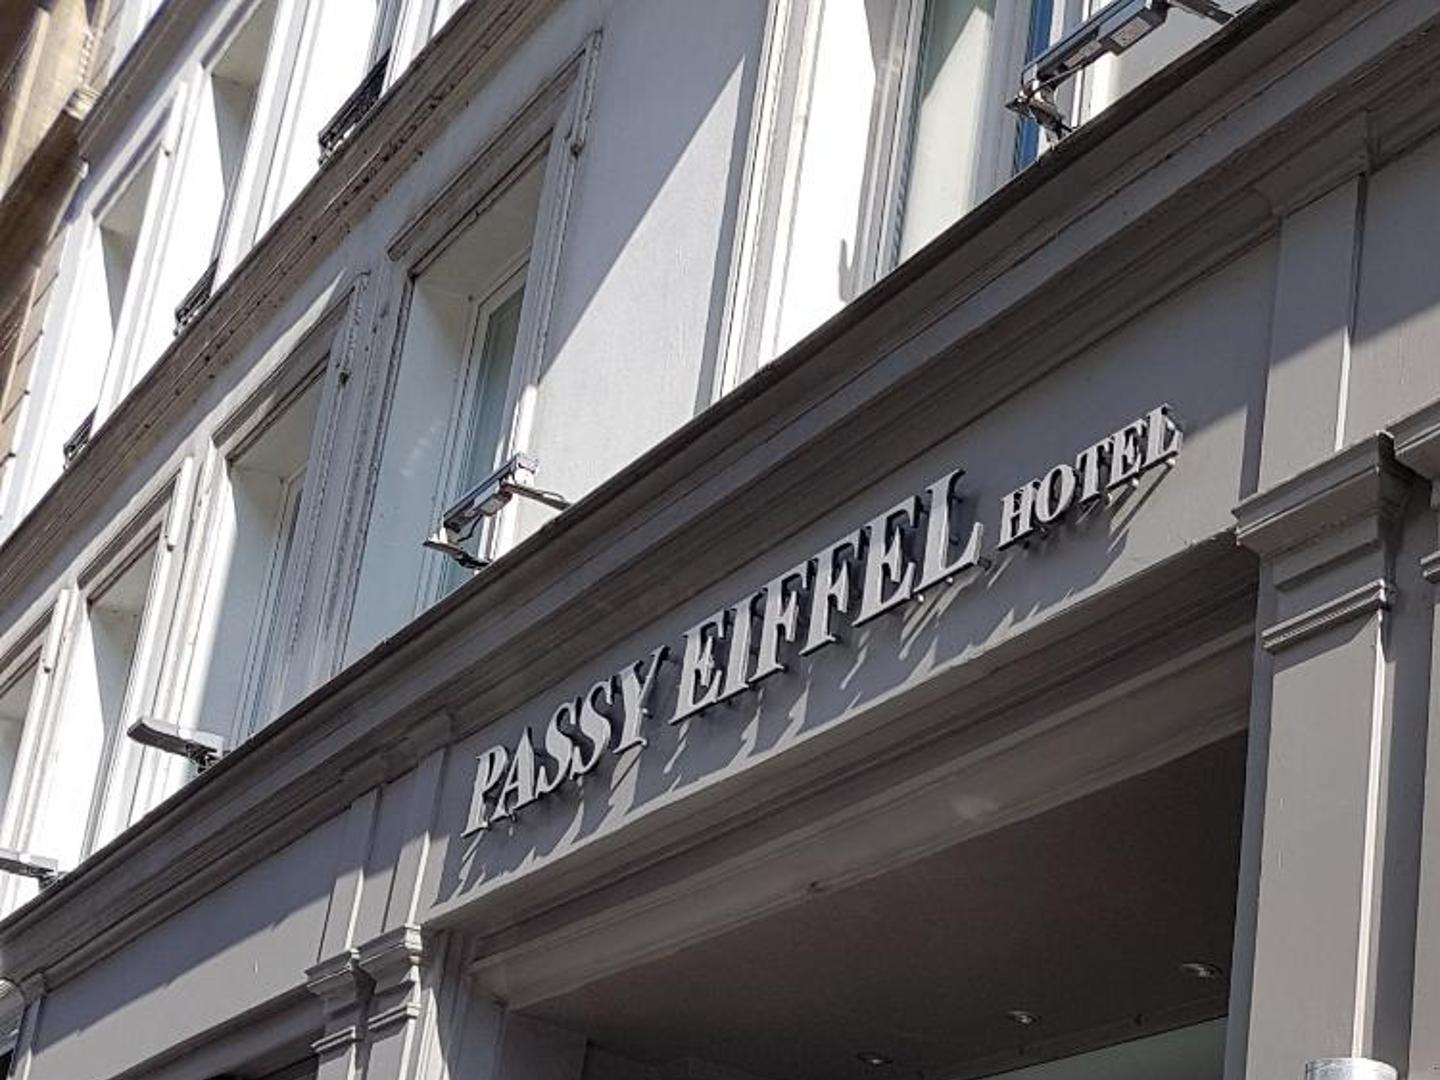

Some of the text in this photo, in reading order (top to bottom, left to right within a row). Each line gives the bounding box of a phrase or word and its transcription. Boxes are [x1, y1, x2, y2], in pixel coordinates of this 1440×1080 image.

[461, 403, 1183, 838] PASSY EIFFEL HOTEL
